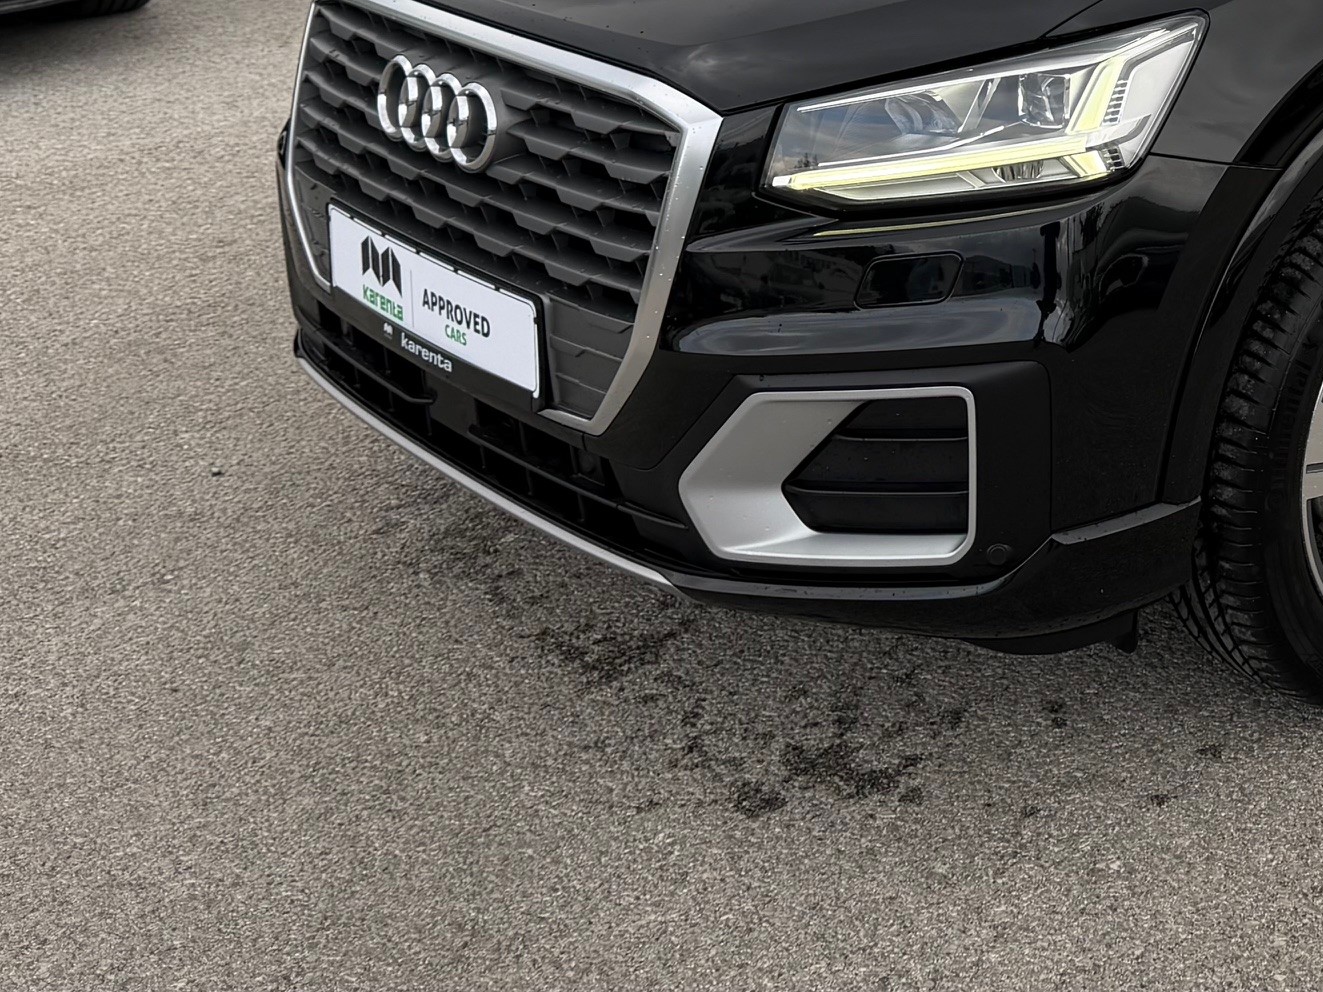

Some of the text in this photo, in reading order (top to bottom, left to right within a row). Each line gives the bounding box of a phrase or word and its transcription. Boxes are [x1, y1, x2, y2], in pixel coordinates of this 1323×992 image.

[363, 284, 403, 321] karenta
[422, 288, 491, 338] APPROVED
[400, 332, 453, 373] karenta
[445, 324, 467, 347] CARS
